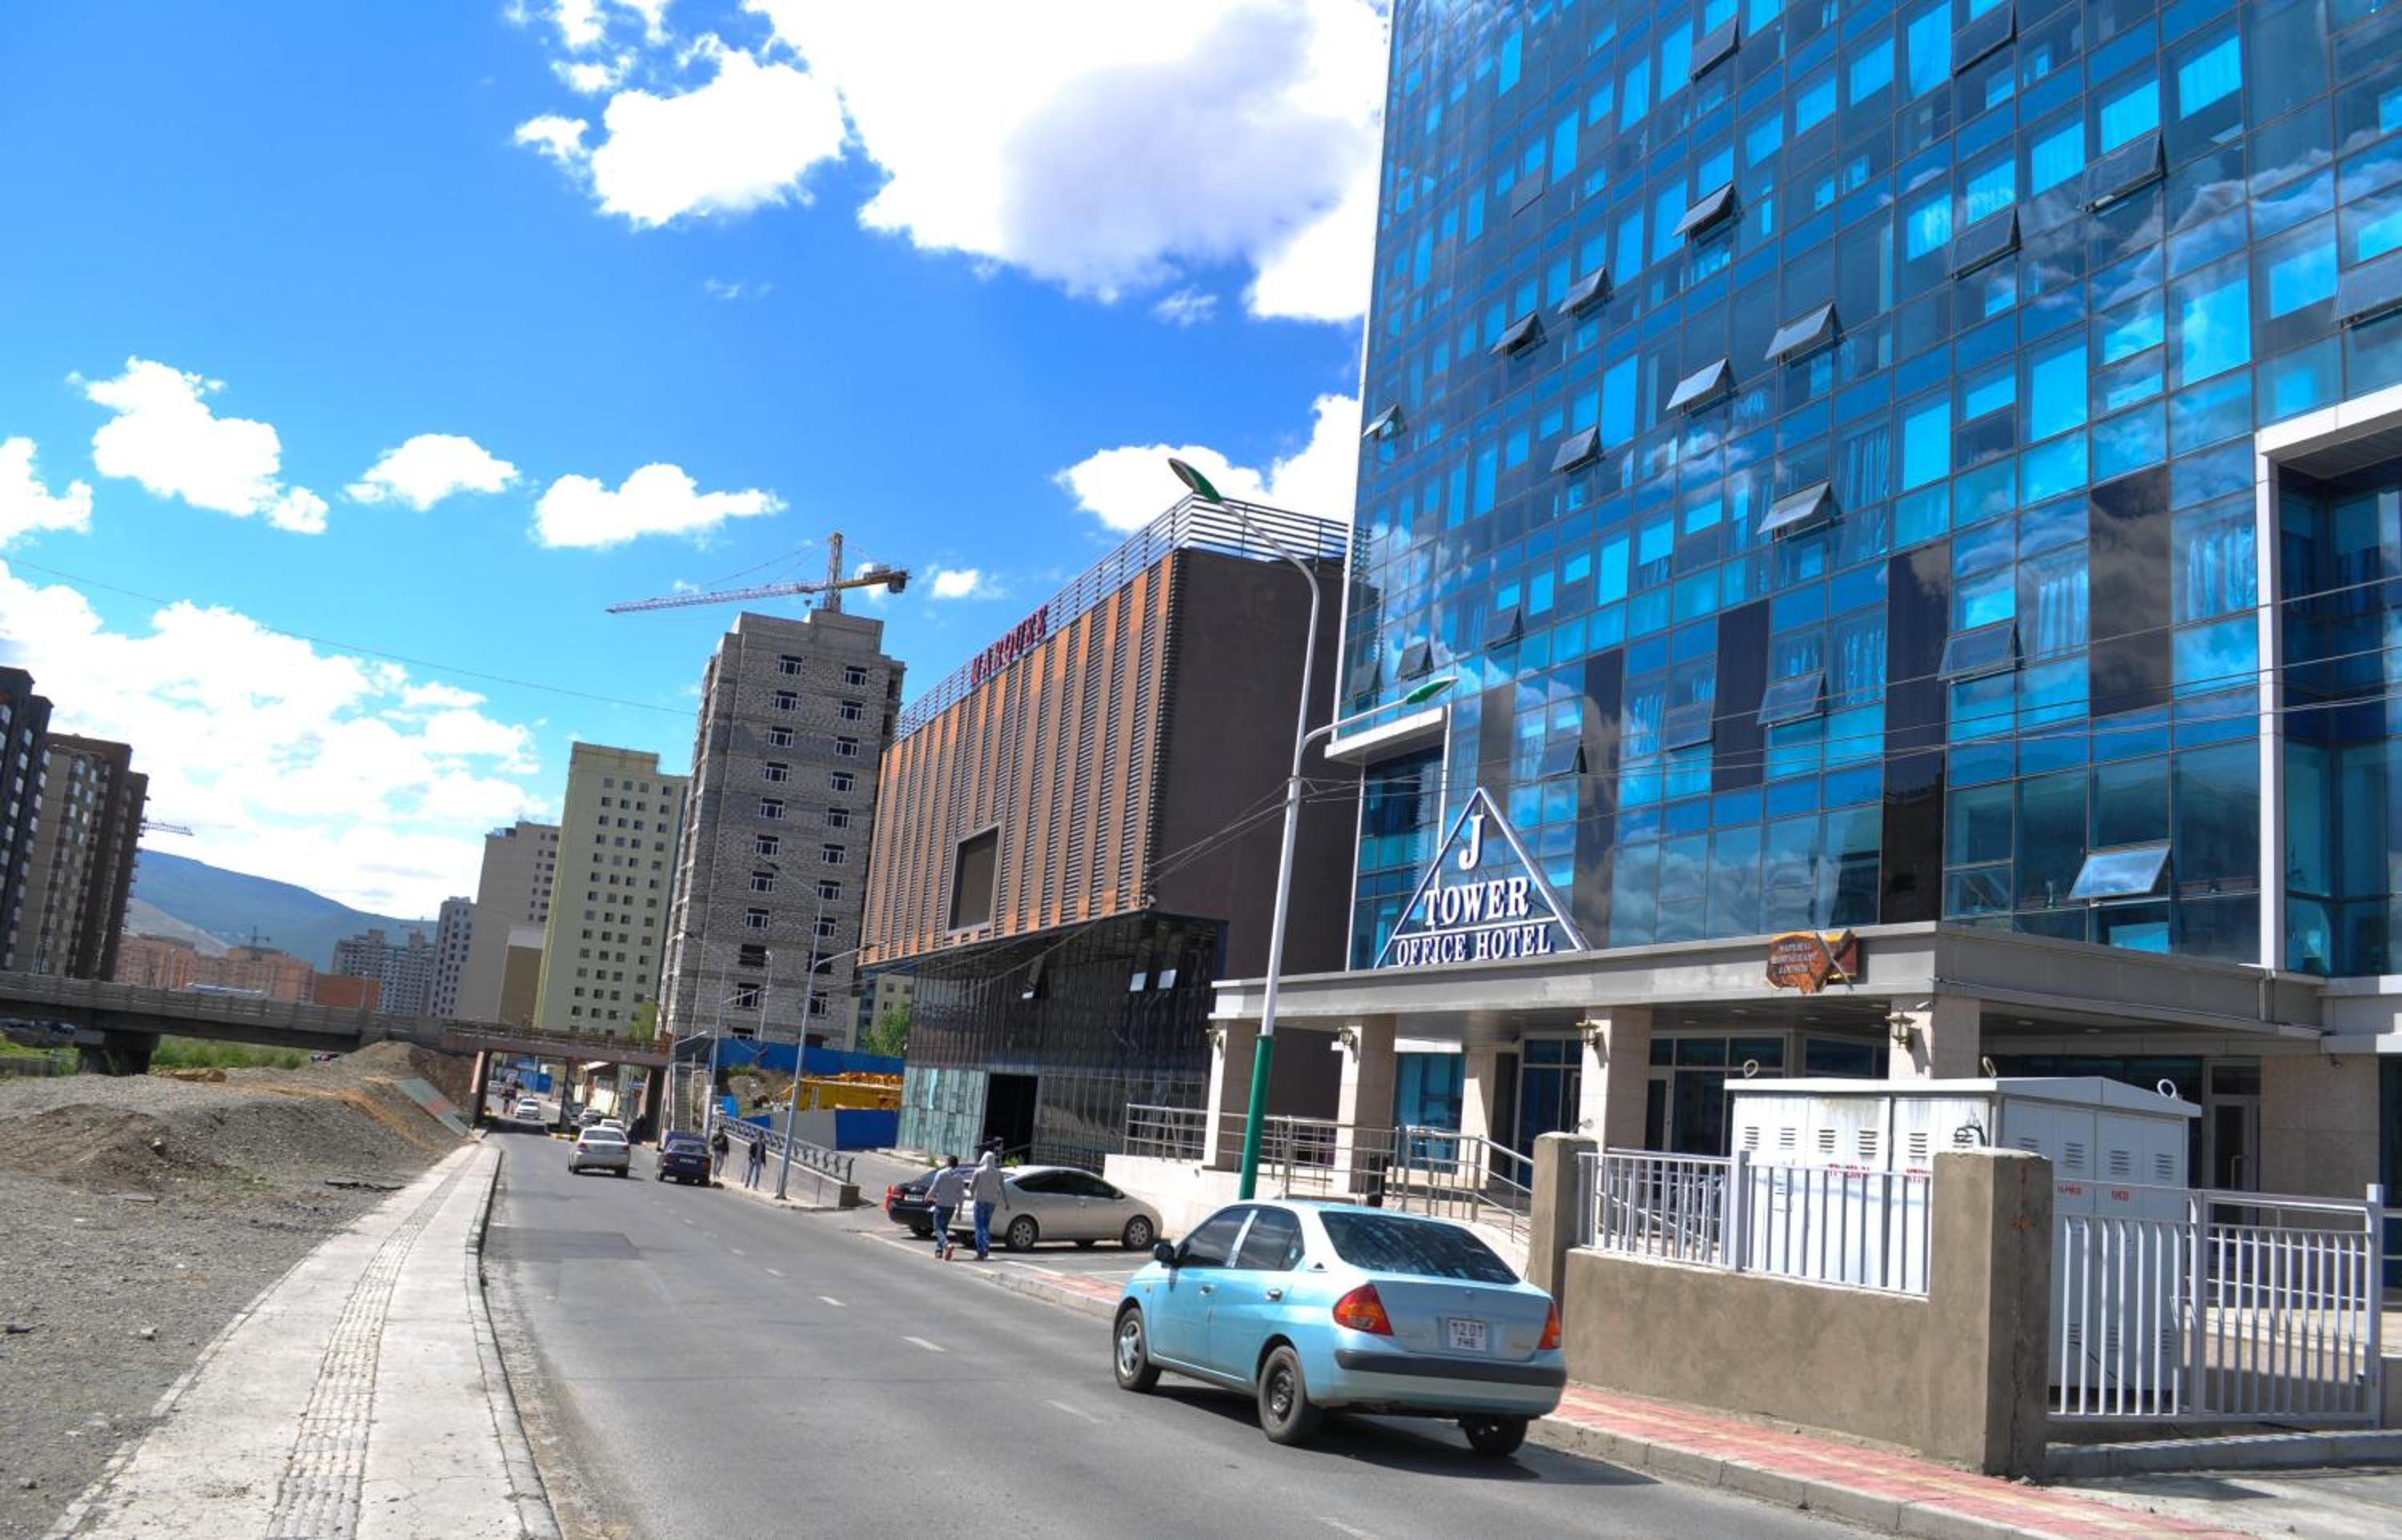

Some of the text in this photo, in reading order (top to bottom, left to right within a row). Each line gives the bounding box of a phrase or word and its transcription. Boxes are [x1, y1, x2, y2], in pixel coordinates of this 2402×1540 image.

[1457, 813, 1484, 870] J
[1423, 876, 1530, 926] TOWER
[1396, 924, 1552, 967] OFFICE HOTEL
